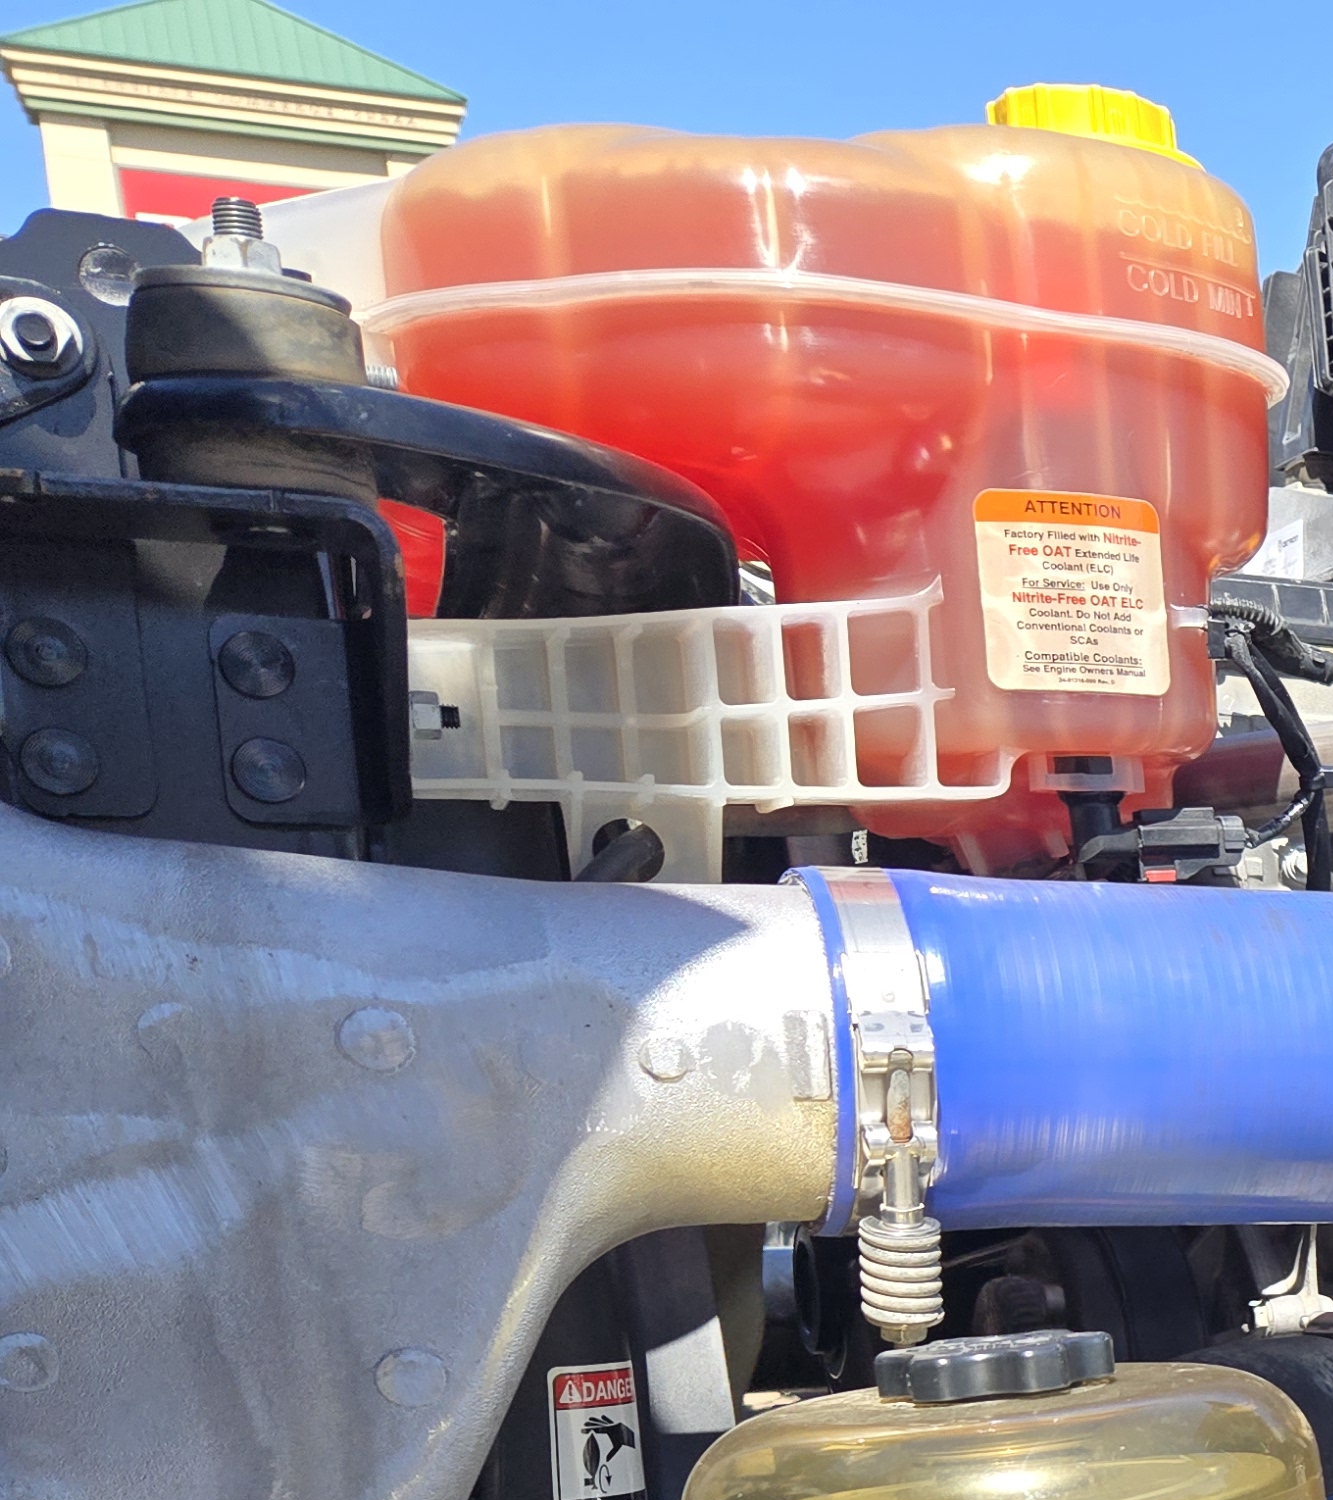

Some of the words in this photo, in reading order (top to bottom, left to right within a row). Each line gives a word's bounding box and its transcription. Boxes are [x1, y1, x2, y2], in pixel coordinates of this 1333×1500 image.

[1118, 209, 1192, 250] COLD
[1202, 230, 1239, 267] FILL
[1127, 264, 1198, 302] COLD
[1207, 283, 1241, 318] MIN
[1025, 500, 1122, 519] ATTENTION
[1004, 529, 1044, 540] Factory
[1047, 531, 1076, 541] Filled
[1079, 533, 1100, 542] with
[1103, 532, 1141, 547] Nitrite-
[1008, 544, 1038, 556] Free
[1043, 545, 1071, 557] OAT
[1075, 549, 1121, 561] Extended
[1123, 551, 1139, 562] Life
[1042, 562, 1083, 573] Coolant
[1086, 563, 1114, 575] (ELC)
[1022, 578, 1040, 588] For
[1043, 578, 1085, 589] Service:
[1091, 581, 1110, 591] Use
[1112, 582, 1133, 594] Only
[1012, 592, 1086, 605] Nitrite-Free
[1090, 595, 1116, 607] OAT
[1121, 598, 1144, 610] ELC
[1029, 608, 1073, 619] Coolant.
[1076, 610, 1090, 619] Do
[1093, 611, 1111, 621] Not
[1114, 612, 1132, 622] Add
[1017, 621, 1086, 633] Conventional
[1089, 624, 1132, 634] Coolants
[1070, 635, 1098, 645] SCAs
[1025, 651, 1090, 663] Compatible
[1093, 653, 1143, 666] Coolants:
[1023, 664, 1040, 673] See
[1044, 665, 1077, 676] Engine
[1079, 666, 1114, 676] Owners
[1116, 668, 1145, 677] Manual
[582, 1380, 635, 1402] DANGE
